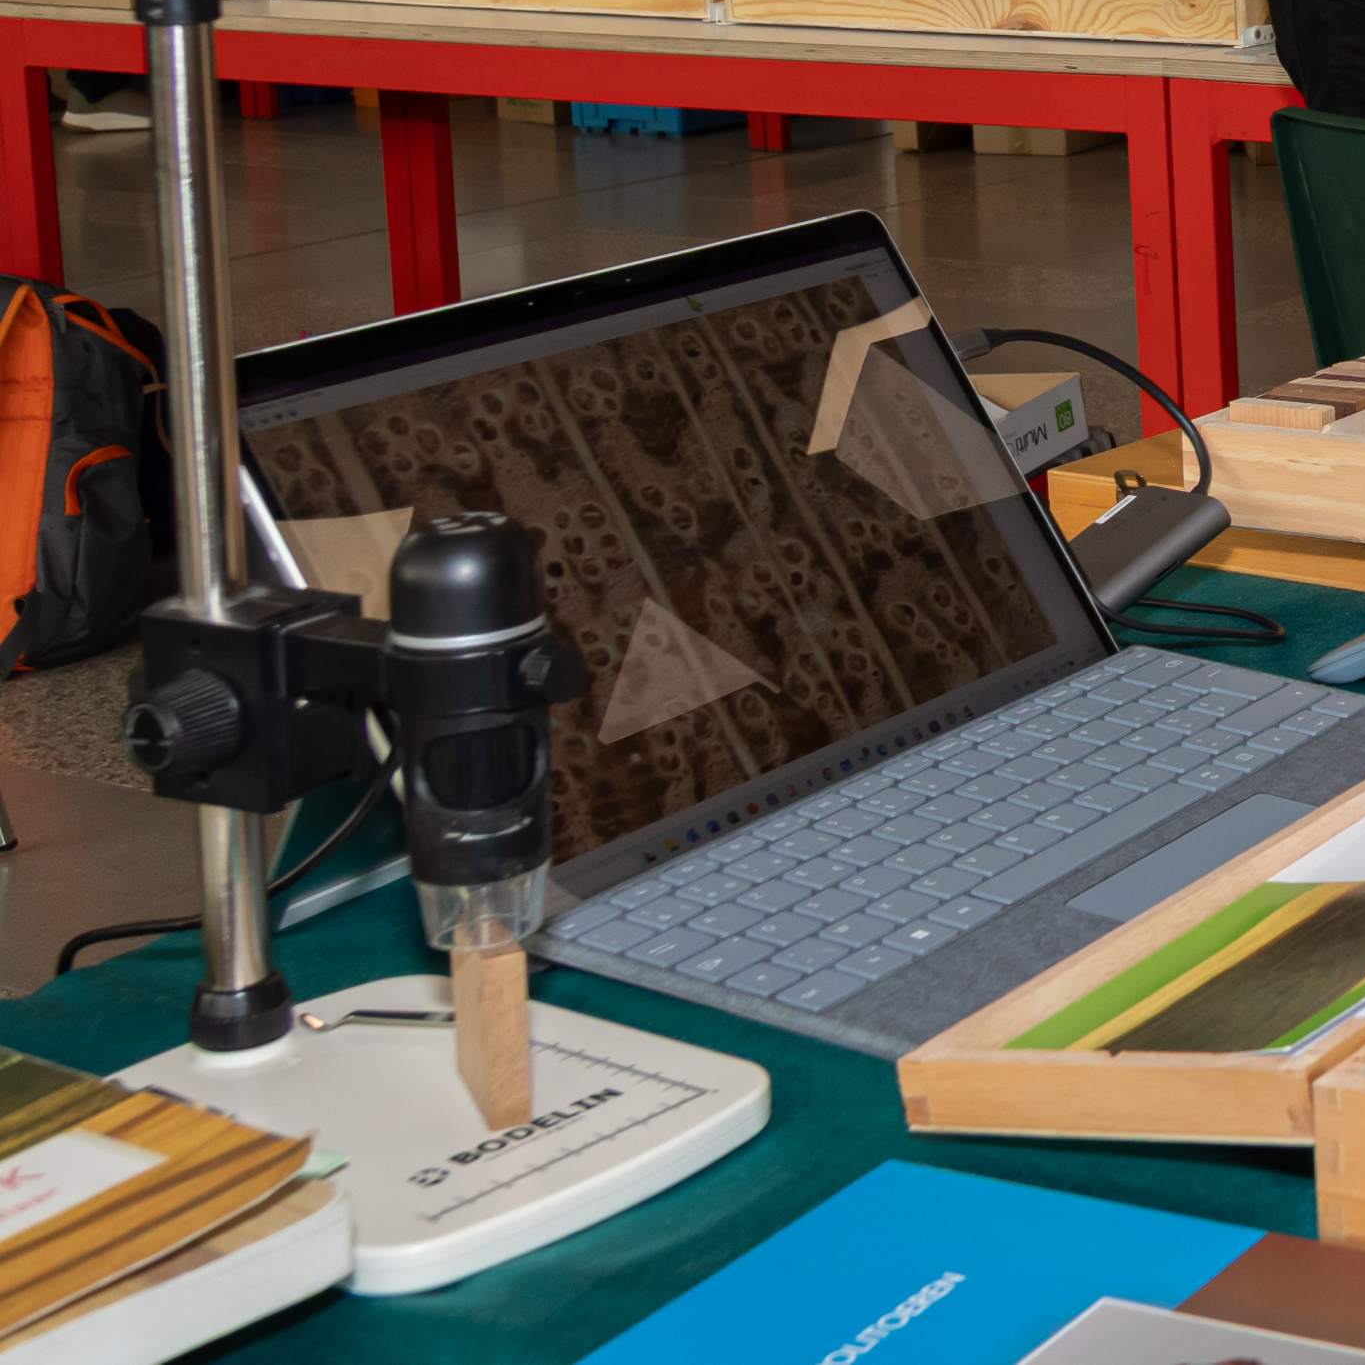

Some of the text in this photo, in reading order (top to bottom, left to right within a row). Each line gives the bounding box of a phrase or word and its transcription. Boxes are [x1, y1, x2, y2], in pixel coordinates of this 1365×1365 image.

[1007, 421, 1049, 457] Multi
[448, 1086, 625, 1166] BODELIN
[814, 1270, 967, 1365] OLITOEREN
